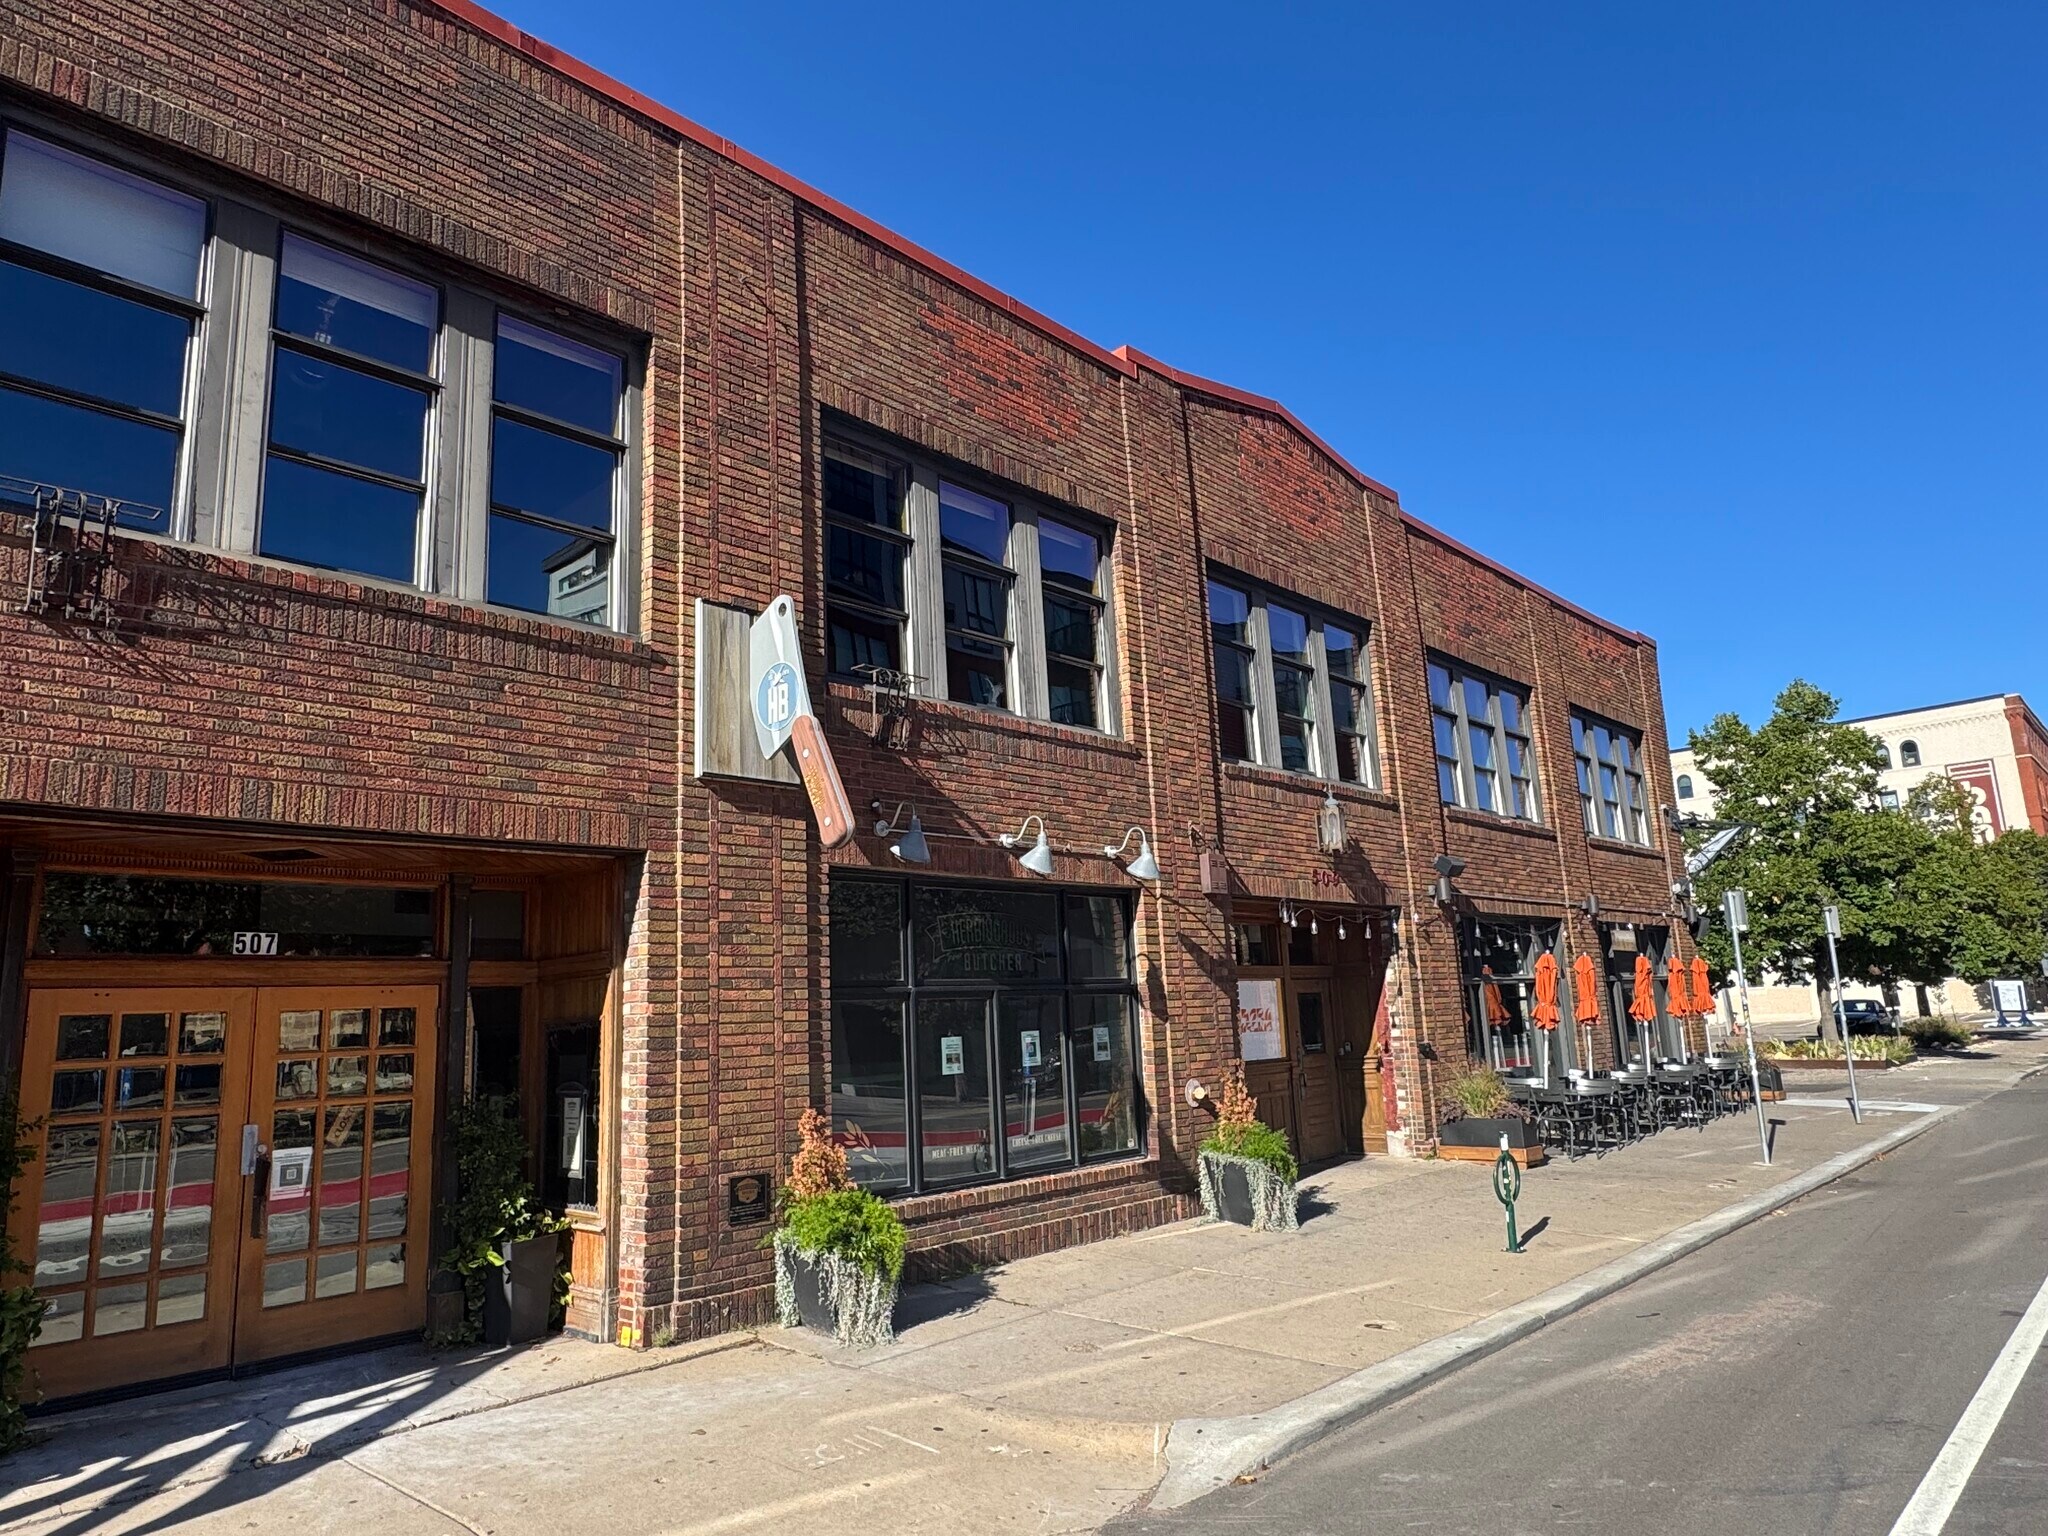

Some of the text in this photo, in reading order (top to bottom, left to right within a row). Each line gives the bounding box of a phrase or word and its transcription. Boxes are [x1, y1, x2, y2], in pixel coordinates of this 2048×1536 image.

[767, 682, 789, 725] HB
[235, 933, 276, 954] 507
[964, 953, 1022, 971] BUTCHER
[932, 1146, 964, 1159] MEAT-FREE
